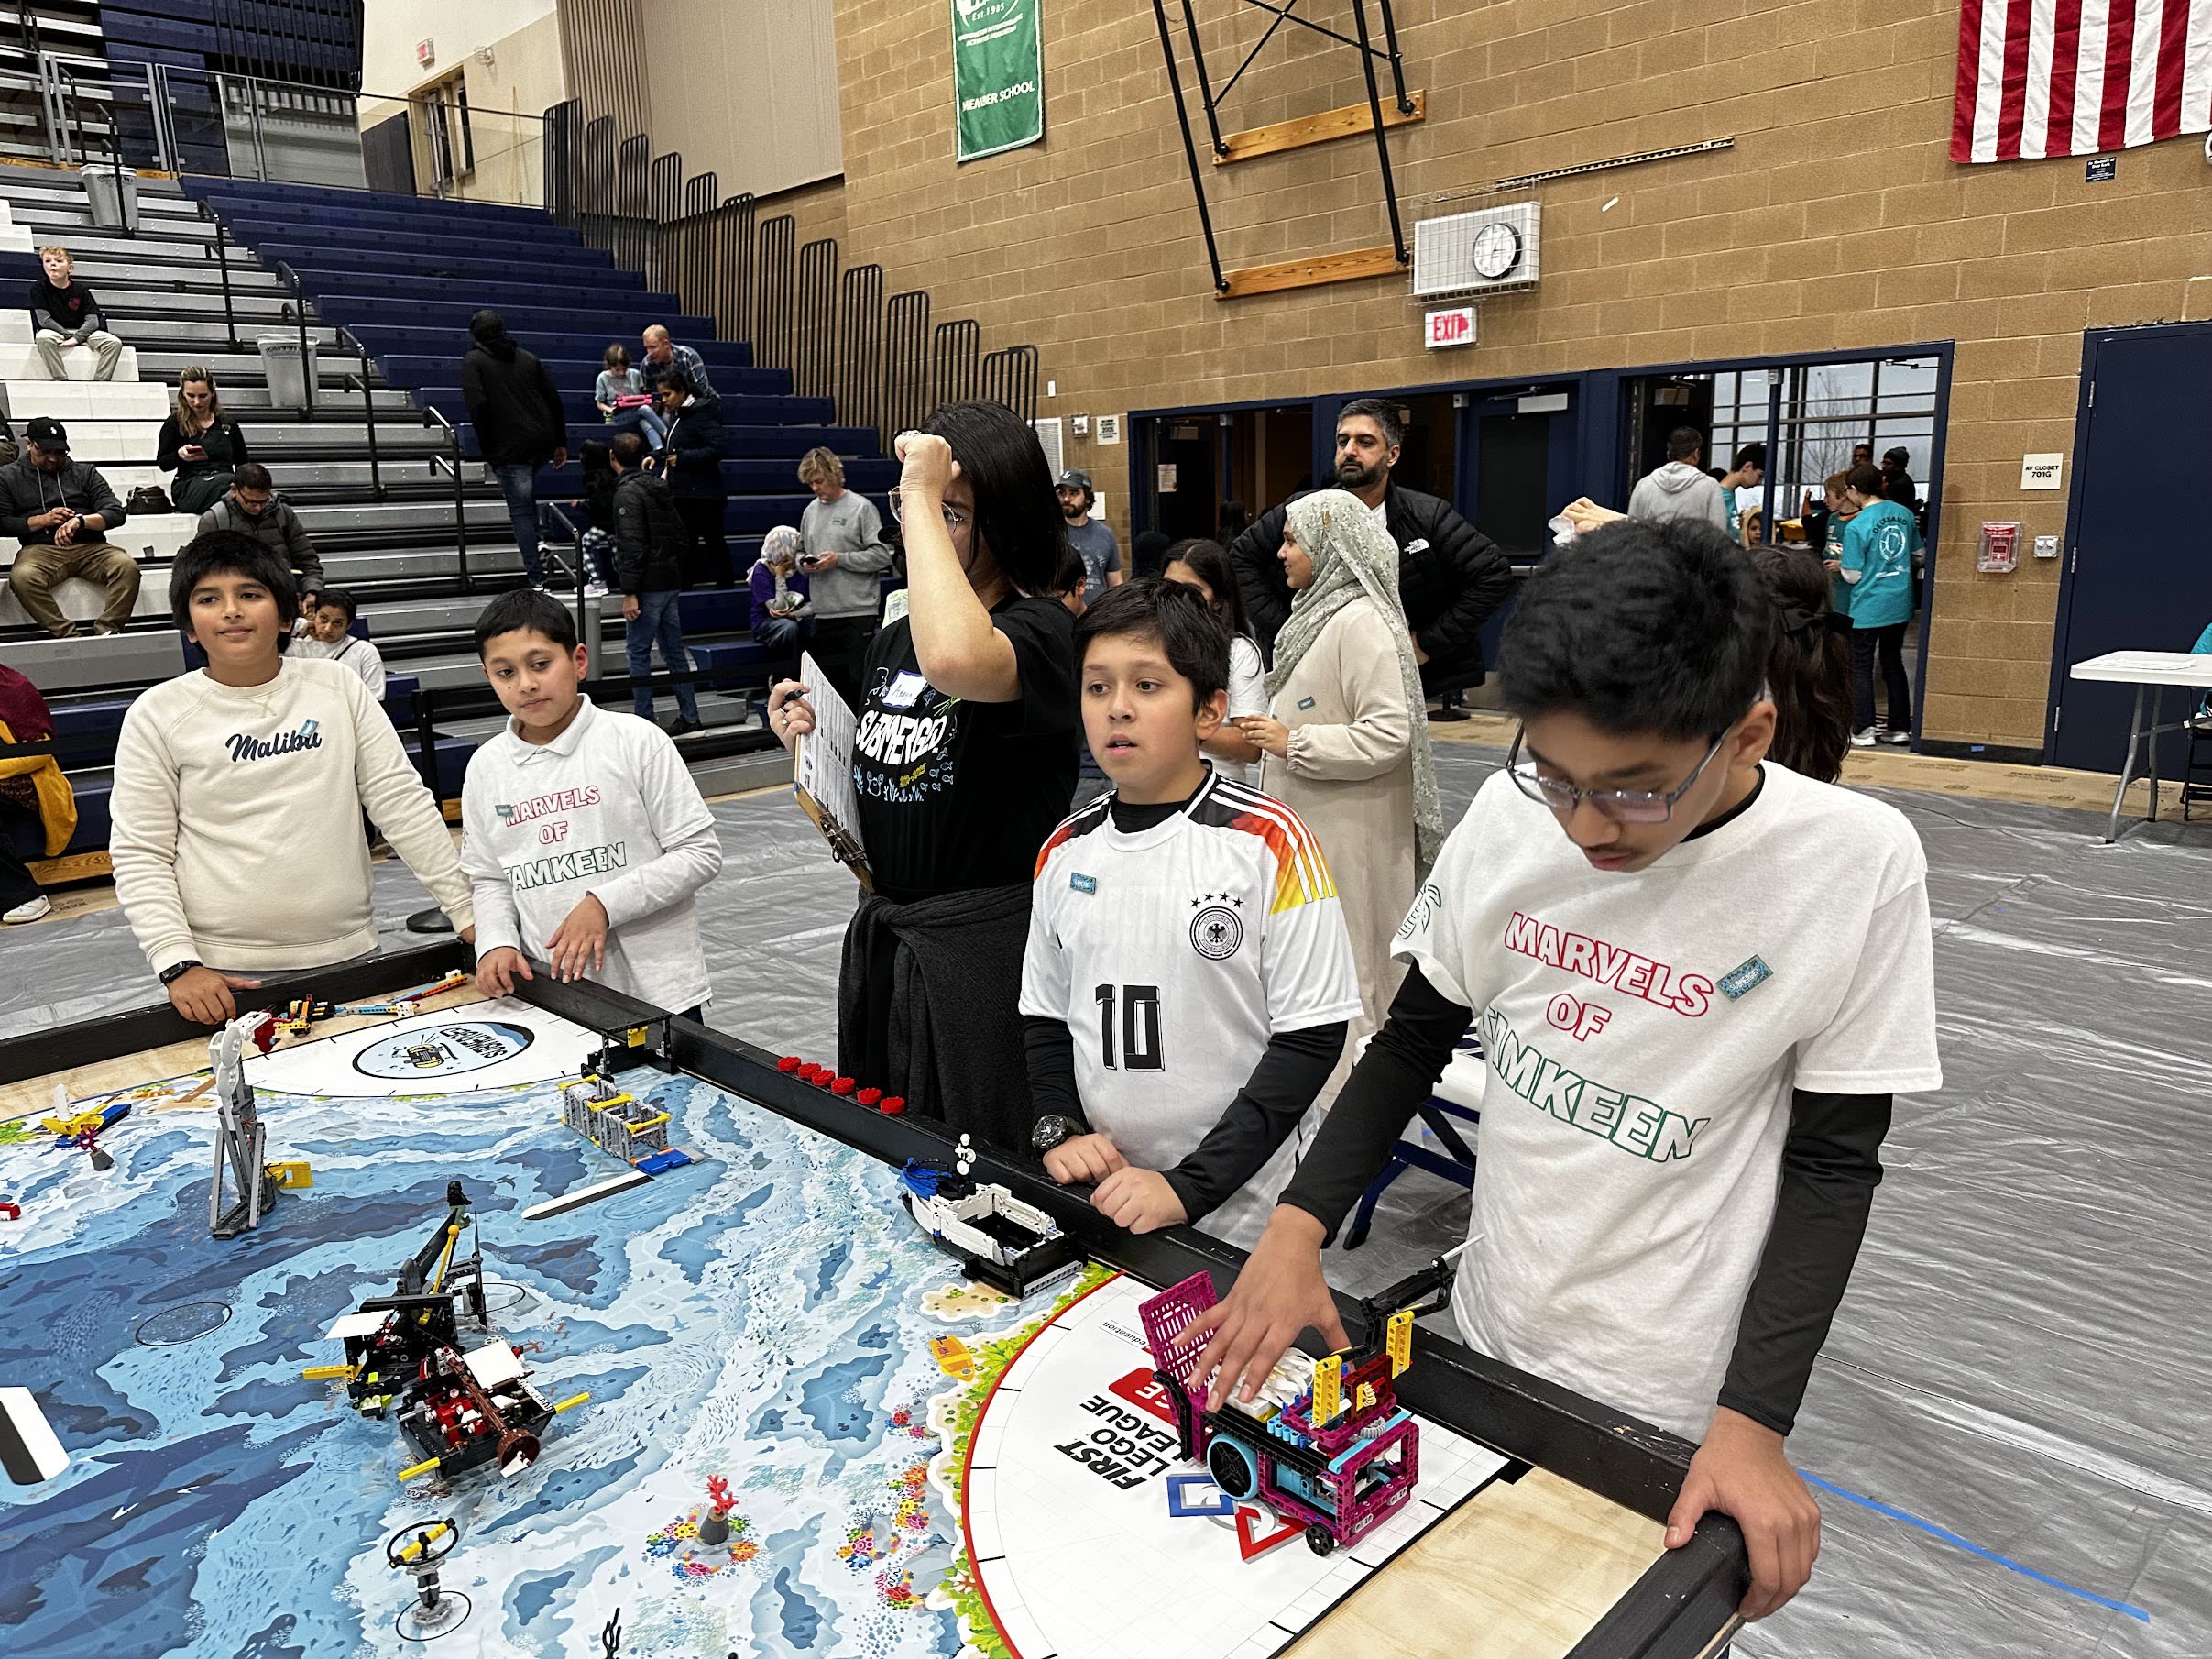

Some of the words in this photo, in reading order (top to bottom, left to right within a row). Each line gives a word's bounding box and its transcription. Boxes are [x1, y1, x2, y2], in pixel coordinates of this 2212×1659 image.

[962, 93, 999, 112] MEMBER
[999, 81, 1035, 102] SCHOOL
[1434, 313, 1462, 342] EXIT
[225, 730, 322, 762] Malibu
[506, 785, 600, 827] MARVELS
[539, 821, 568, 844] OF
[1505, 911, 1714, 1016] MARVELS
[1095, 983, 1166, 1071] 10
[1547, 994, 1612, 1041] OF
[1102, 1321, 1146, 1346] education
[1053, 1440, 1147, 1490] FIRST
[1090, 1428, 1171, 1477] LEGO
